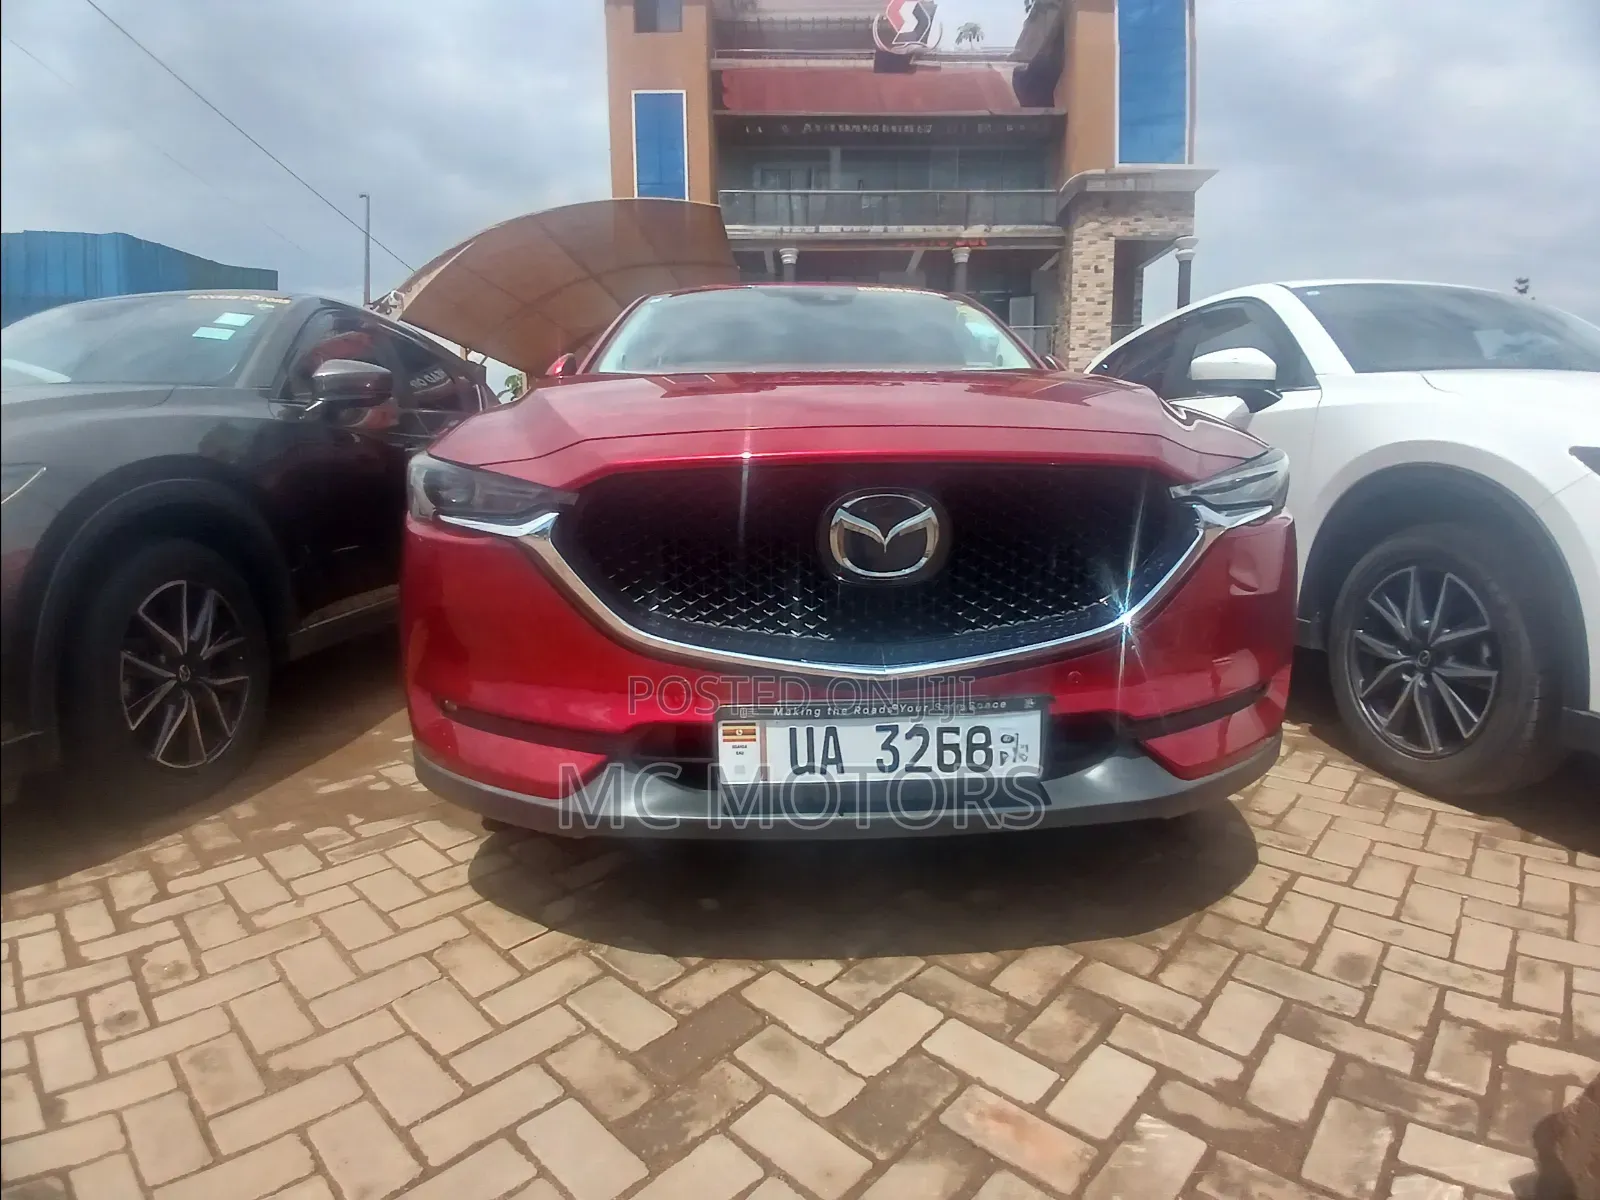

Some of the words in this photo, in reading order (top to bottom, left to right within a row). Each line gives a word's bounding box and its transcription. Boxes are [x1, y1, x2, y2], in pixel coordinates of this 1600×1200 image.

[774, 706, 821, 718] Making
[827, 706, 848, 716] the
[899, 703, 929, 713] Your
[789, 726, 845, 776] UA
